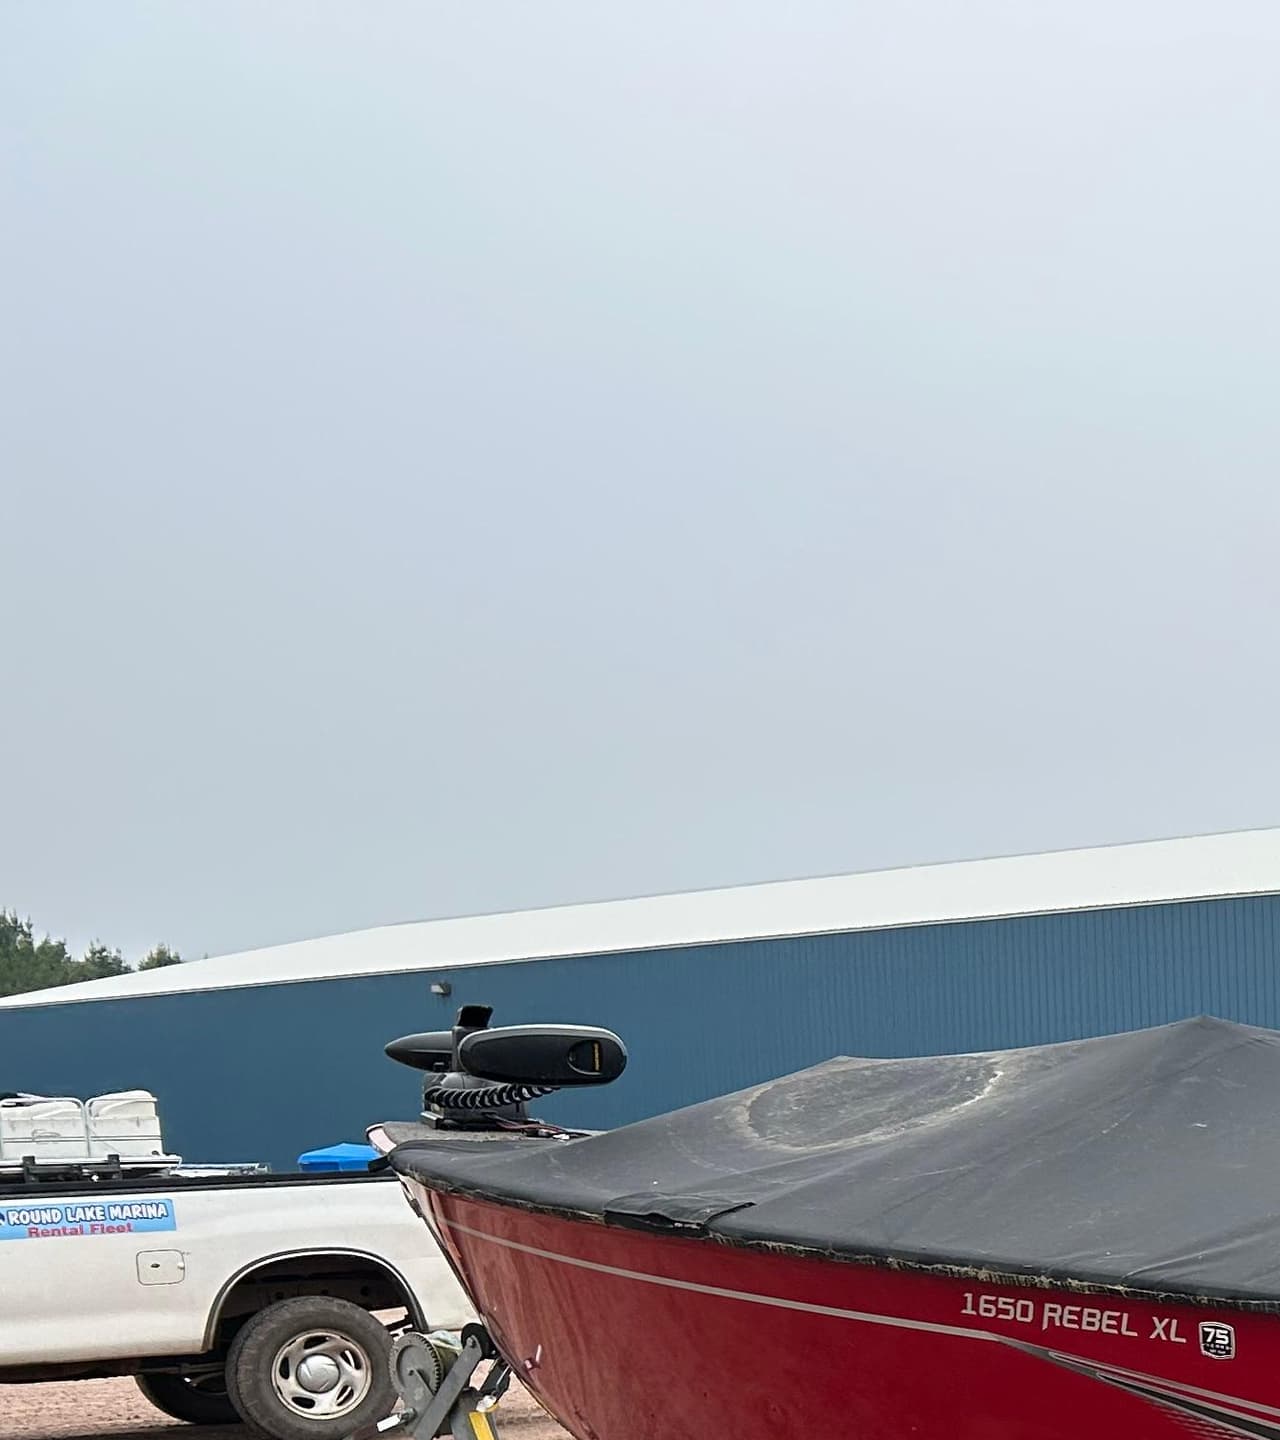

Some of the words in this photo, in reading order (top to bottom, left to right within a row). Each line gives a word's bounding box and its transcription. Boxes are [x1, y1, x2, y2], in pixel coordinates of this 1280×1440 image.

[7, 1208, 62, 1226] ROUND
[65, 1205, 106, 1223] LAKE
[109, 1202, 168, 1220] MARINA
[28, 1224, 84, 1238] Rental
[90, 1222, 133, 1235] Fleet
[960, 1293, 1034, 1322] 1650
[1042, 1303, 1138, 1337] REBEL
[1149, 1316, 1187, 1343] XL
[1203, 1327, 1230, 1345] 75
